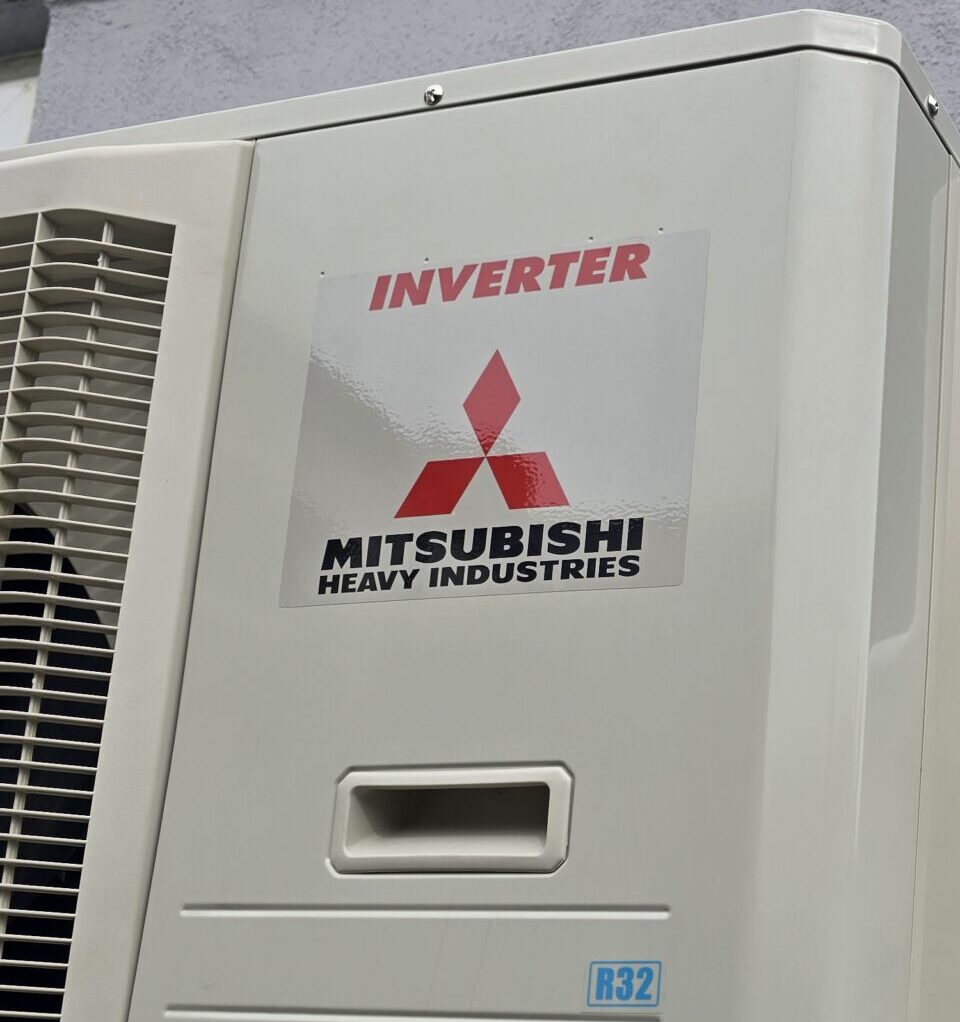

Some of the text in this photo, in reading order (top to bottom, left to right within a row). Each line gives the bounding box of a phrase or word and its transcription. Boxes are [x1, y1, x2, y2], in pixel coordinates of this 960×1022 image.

[368, 243, 651, 311] INVERTER
[321, 517, 644, 571] MITSUBISHI
[318, 555, 641, 595] HEAVY INDUSTRIES
[595, 967, 654, 1001] R32
